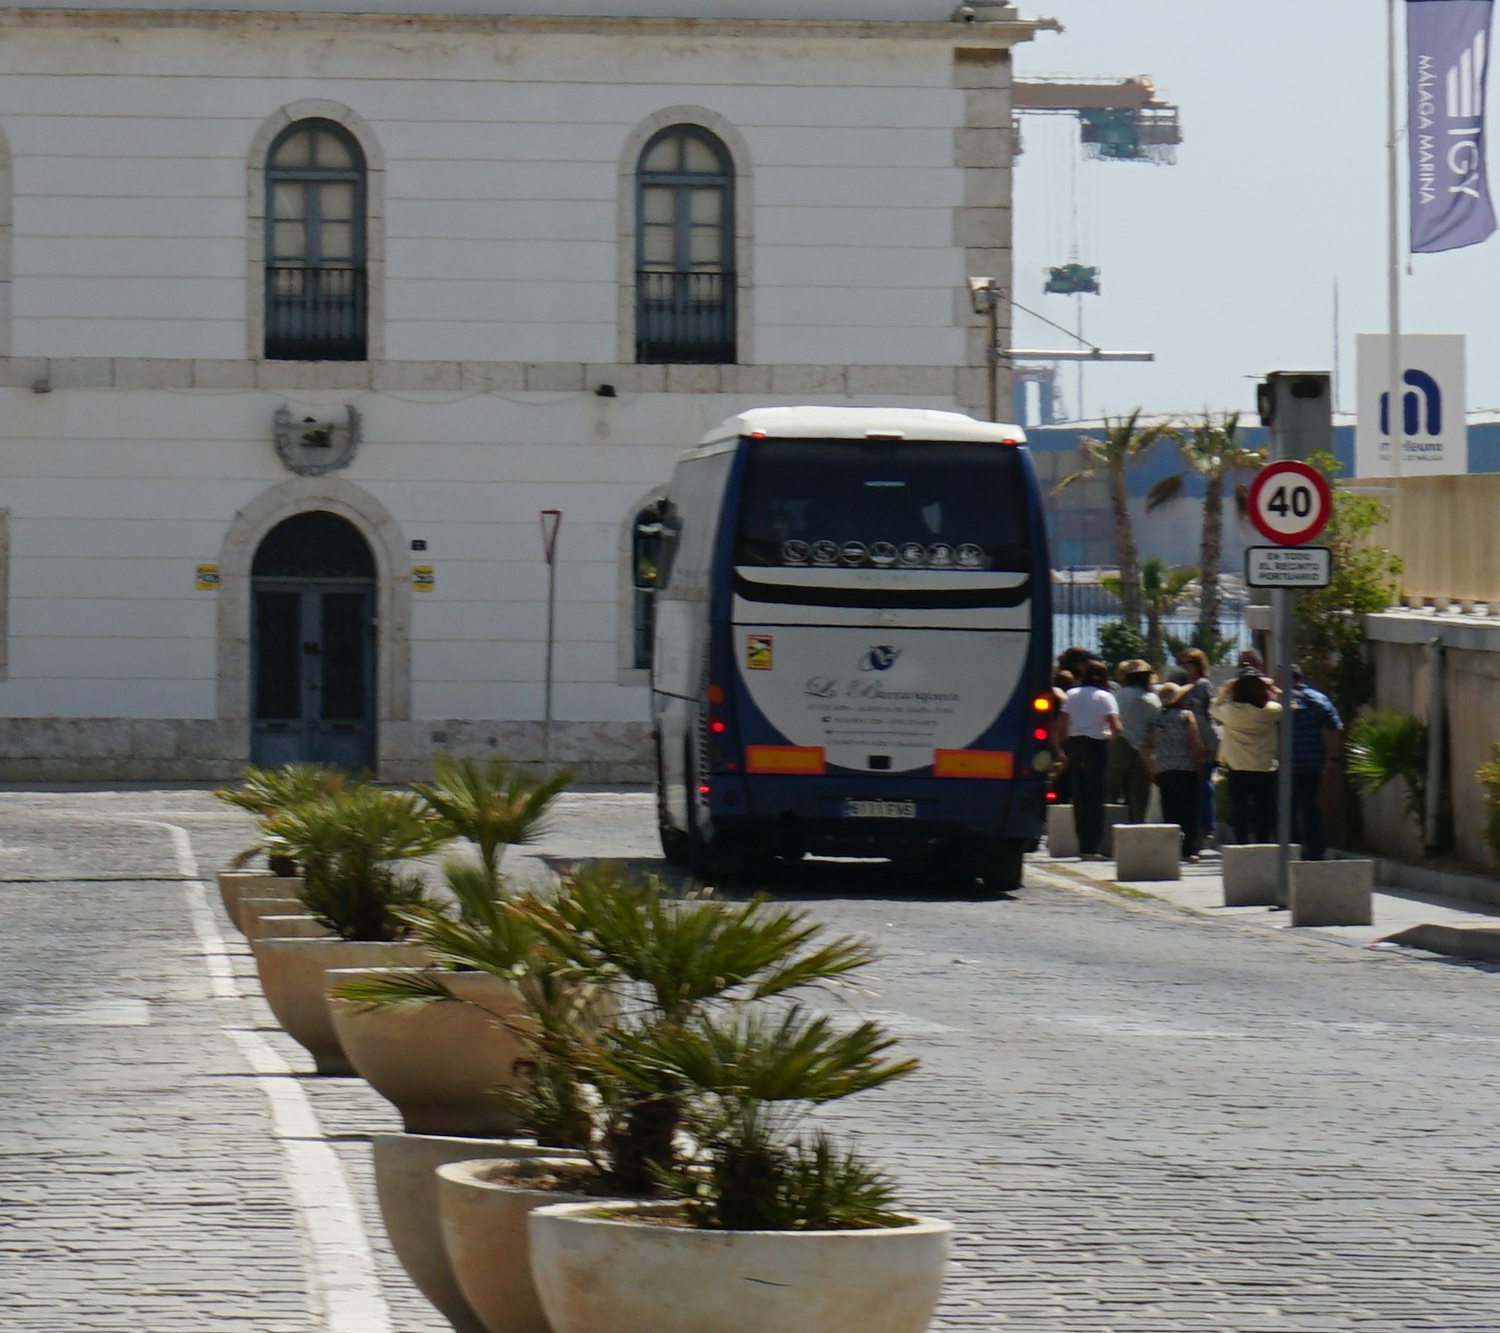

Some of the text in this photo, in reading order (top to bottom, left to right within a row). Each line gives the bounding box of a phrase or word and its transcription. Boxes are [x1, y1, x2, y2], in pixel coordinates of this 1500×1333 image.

[1418, 54, 1437, 205] MÁLAGA MARINA
[1447, 128, 1481, 199] IGY
[1267, 486, 1312, 518] 40
